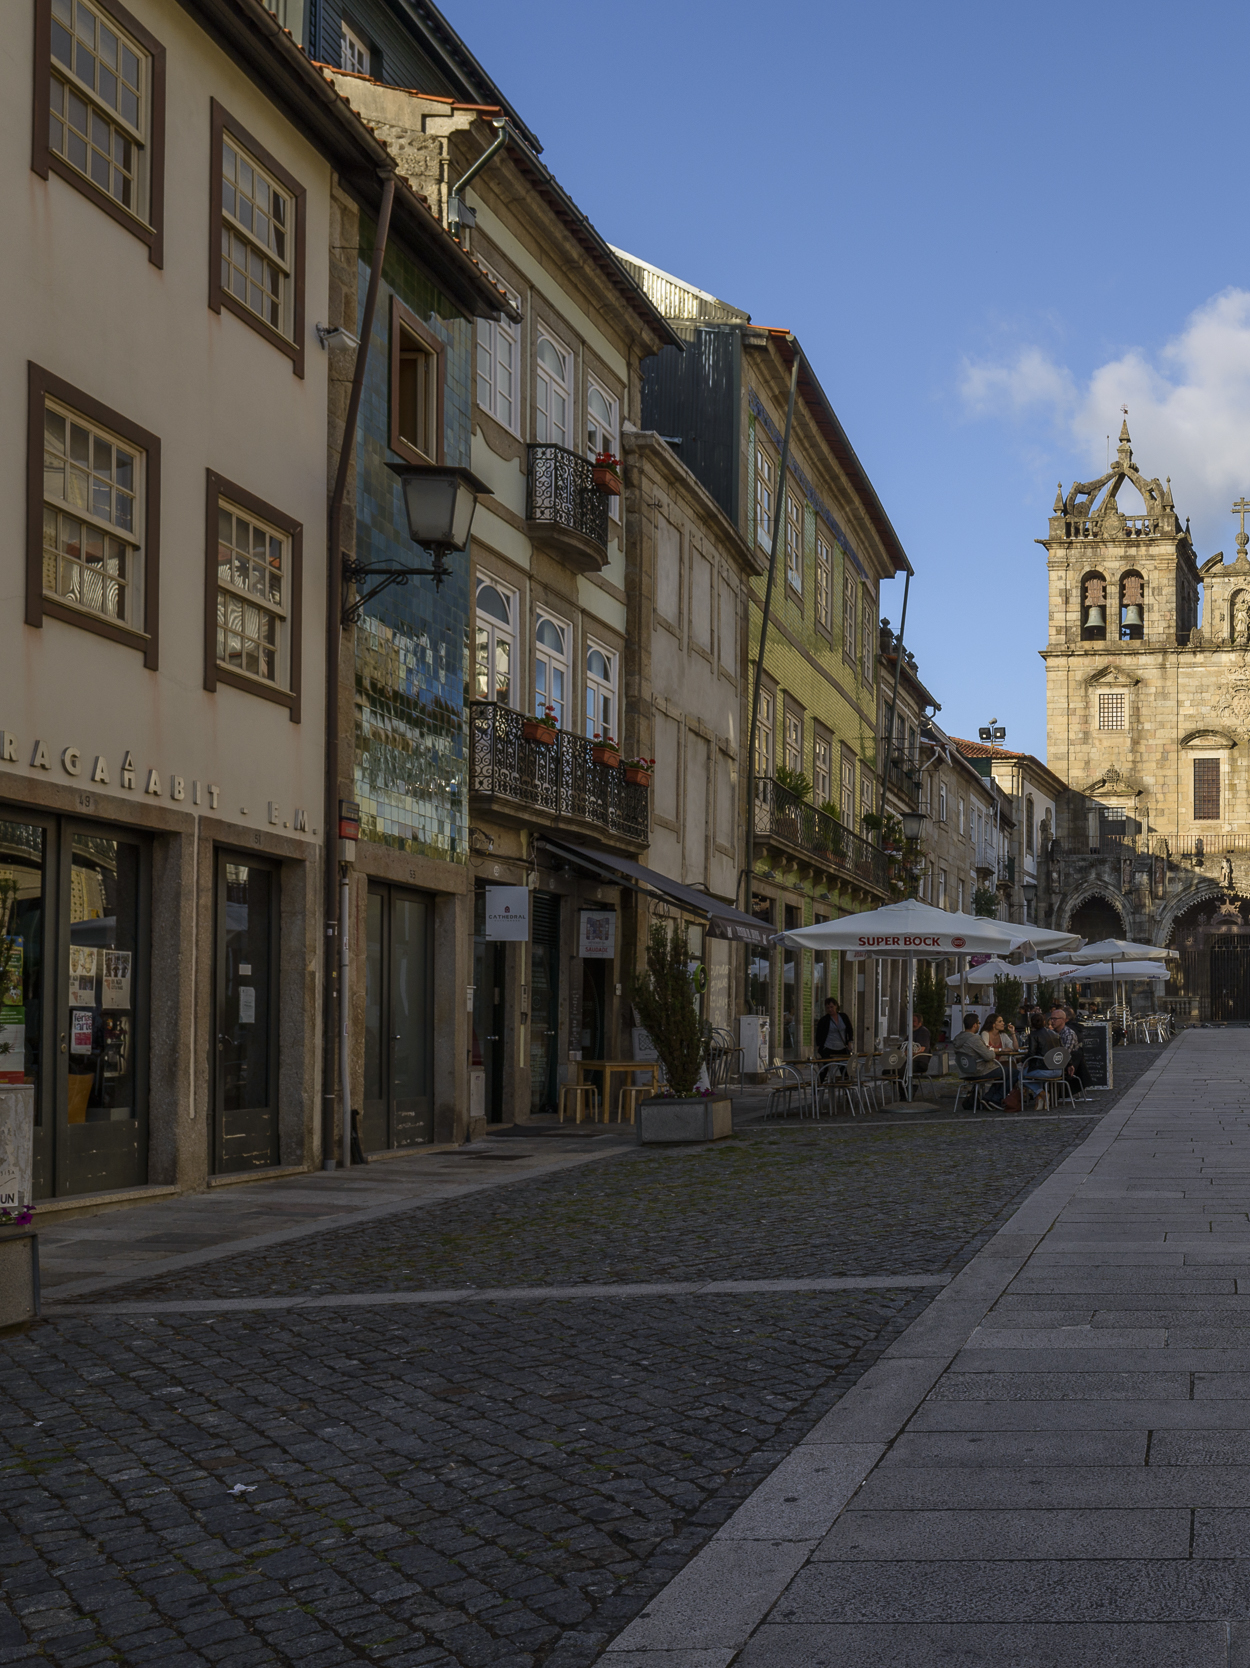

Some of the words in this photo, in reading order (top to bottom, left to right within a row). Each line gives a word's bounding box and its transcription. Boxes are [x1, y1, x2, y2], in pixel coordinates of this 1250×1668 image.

[79, 795, 91, 808] 49
[267, 801, 318, 835] E.M.
[858, 936, 900, 946] SUPER
[904, 936, 941, 946] BOCK
